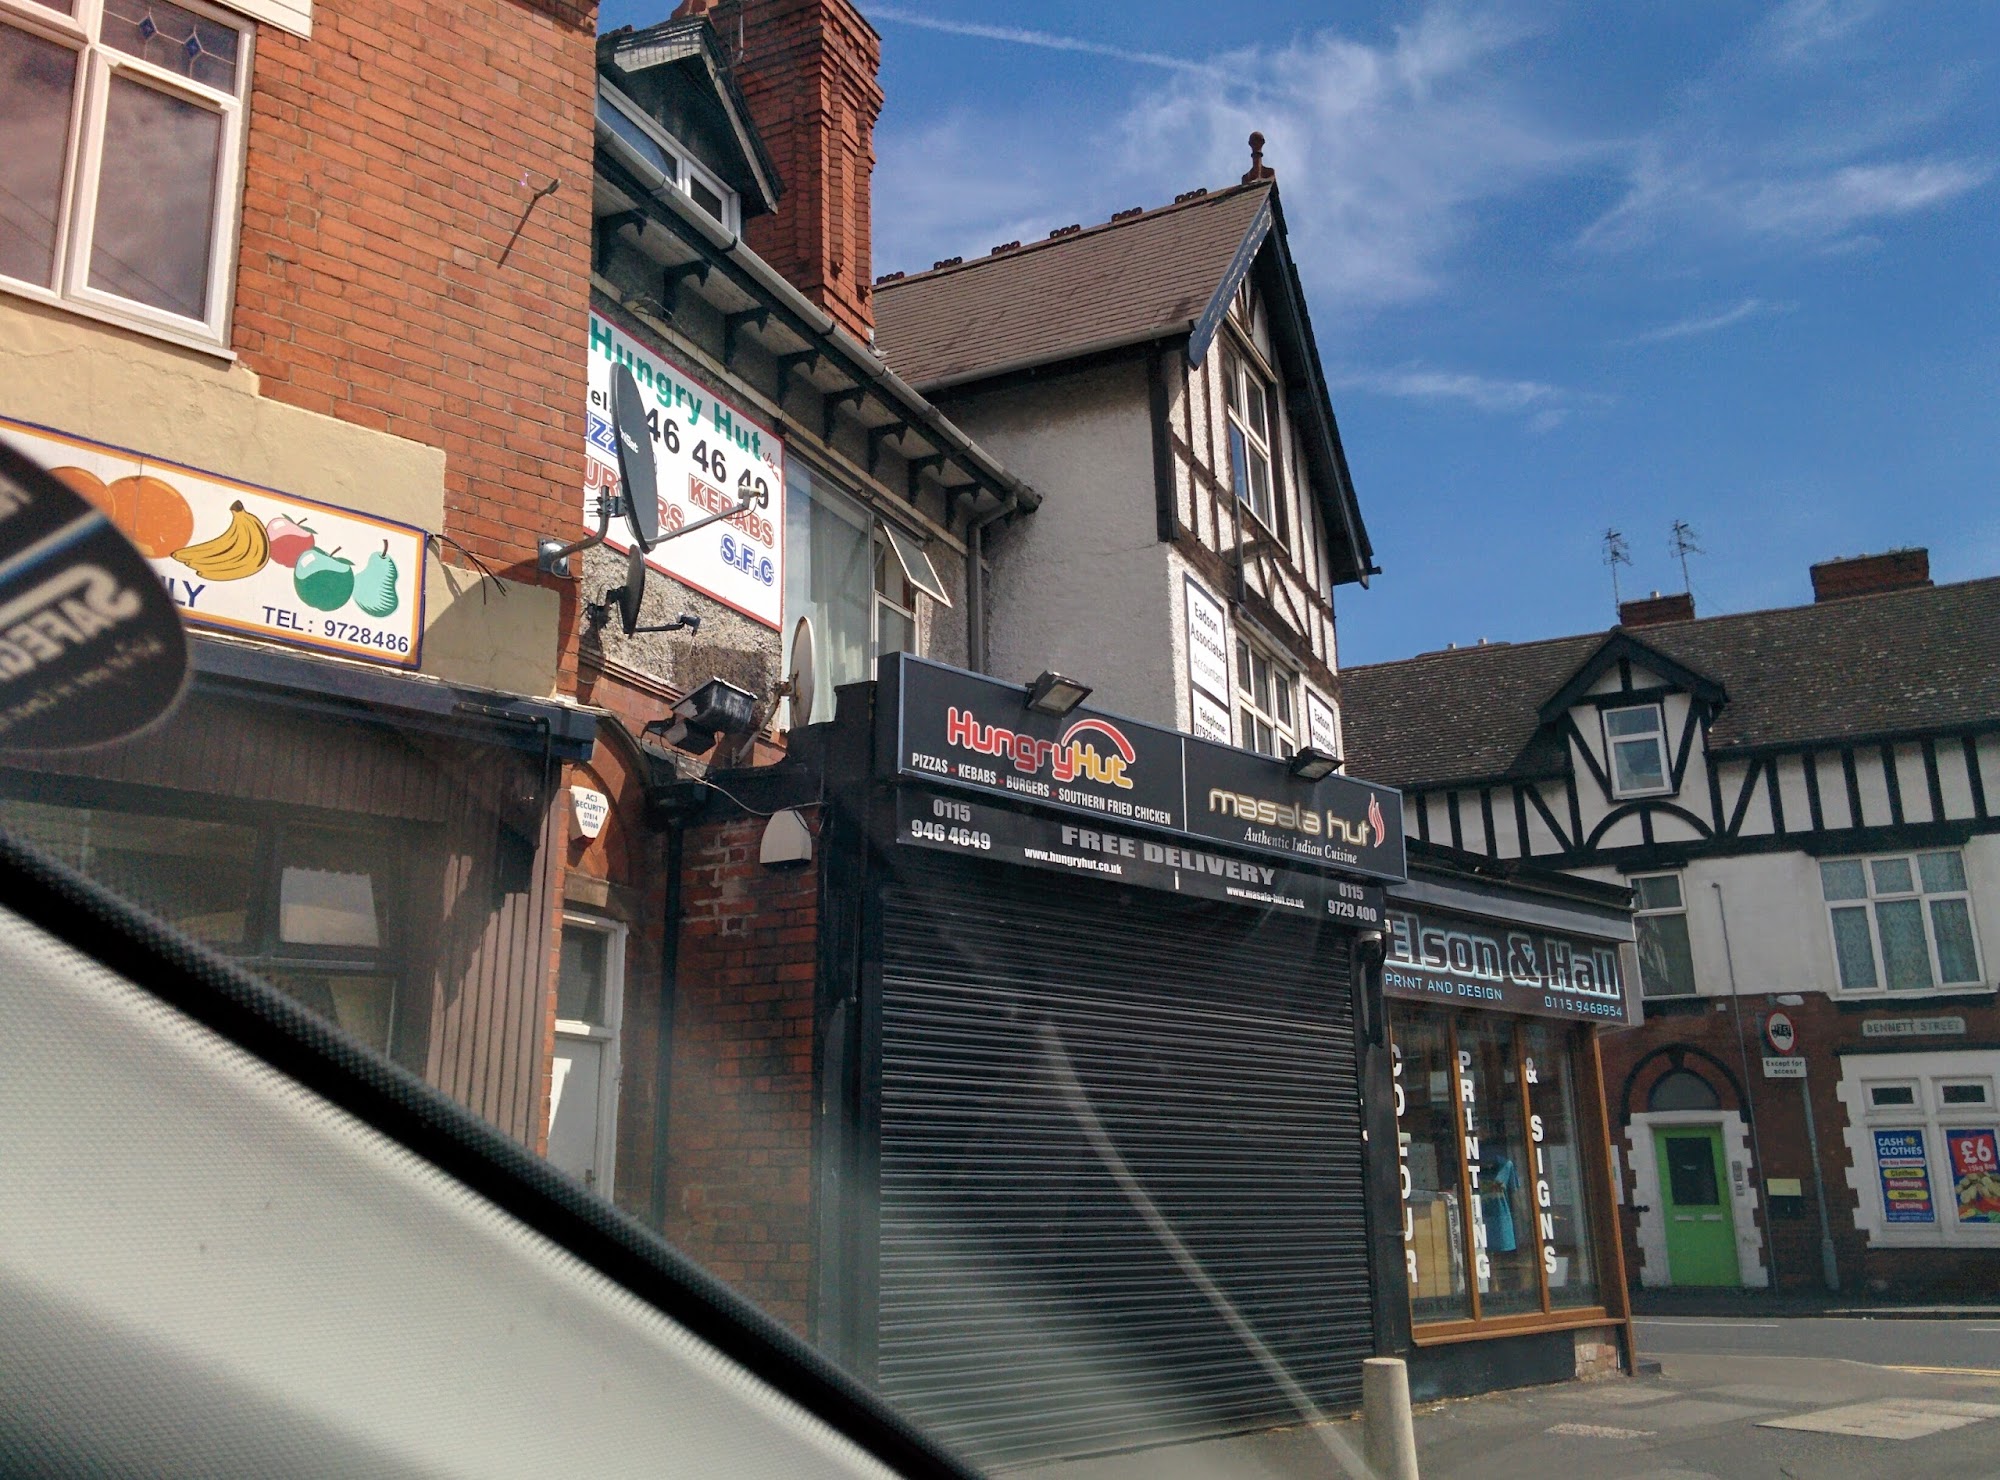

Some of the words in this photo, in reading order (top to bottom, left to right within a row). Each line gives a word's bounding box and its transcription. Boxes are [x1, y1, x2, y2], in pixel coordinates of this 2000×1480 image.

[590, 316, 703, 426] Hungry
[714, 404, 762, 461] Hut
[692, 439, 727, 483] 46
[688, 473, 774, 549] KEBABS
[721, 533, 774, 587] S.F.C
[262, 605, 313, 633] TEL:
[324, 620, 409, 653] 9728486
[1194, 602, 1219, 635] Eadson
[1191, 622, 1226, 664] Associates
[1194, 653, 1226, 690] Accountants
[1314, 708, 1331, 733] Eadson
[912, 752, 948, 774] PIZZAS
[958, 763, 997, 786] KEBABS
[1006, 775, 1050, 798] BURGERS
[1058, 787, 1106, 811] SOUTHERN
[1107, 799, 1133, 817] FRIED
[1134, 805, 1172, 825] CHICKEN
[576, 800, 606, 813] SECURITY
[933, 798, 971, 822] 0115
[1209, 788, 1321, 835] masala
[1326, 809, 1371, 847] hut
[911, 819, 946, 842] 946
[948, 825, 991, 851] 4649
[1243, 826, 1290, 850] Authentic
[1291, 837, 1323, 857] Indian
[1324, 844, 1358, 865] Cuisine
[1024, 848, 1123, 876] www.hungryhut.co.uk
[1061, 825, 1136, 859] FREE
[1142, 841, 1276, 886] DELIVERY
[1338, 882, 1364, 901] 0115
[1327, 900, 1355, 919] 9729
[1356, 904, 1377, 923] 400
[1384, 908, 1504, 982] Elson
[1507, 931, 1542, 988] &
[1544, 936, 1621, 1000] Hall
[1385, 973, 1422, 990] PRINT
[1427, 979, 1453, 995] AND
[1457, 982, 1503, 1001] DESIGN
[1544, 996, 1573, 1012] 0115
[1576, 1001, 1622, 1017] 9468954
[1866, 1021, 1915, 1034] BENNETT
[1920, 1019, 1961, 1032] STREET
[1525, 1057, 1538, 1084] &
[1766, 1060, 1790, 1069] Except
[1791, 1060, 1803, 1068] for
[1878, 1138, 1904, 1147] CASH
[1880, 1146, 1923, 1156] CLOTHES
[1960, 1138, 1992, 1164] £6
[1458, 1050, 1490, 1279] PRINTING
[1530, 1114, 1558, 1274] SIGNS
